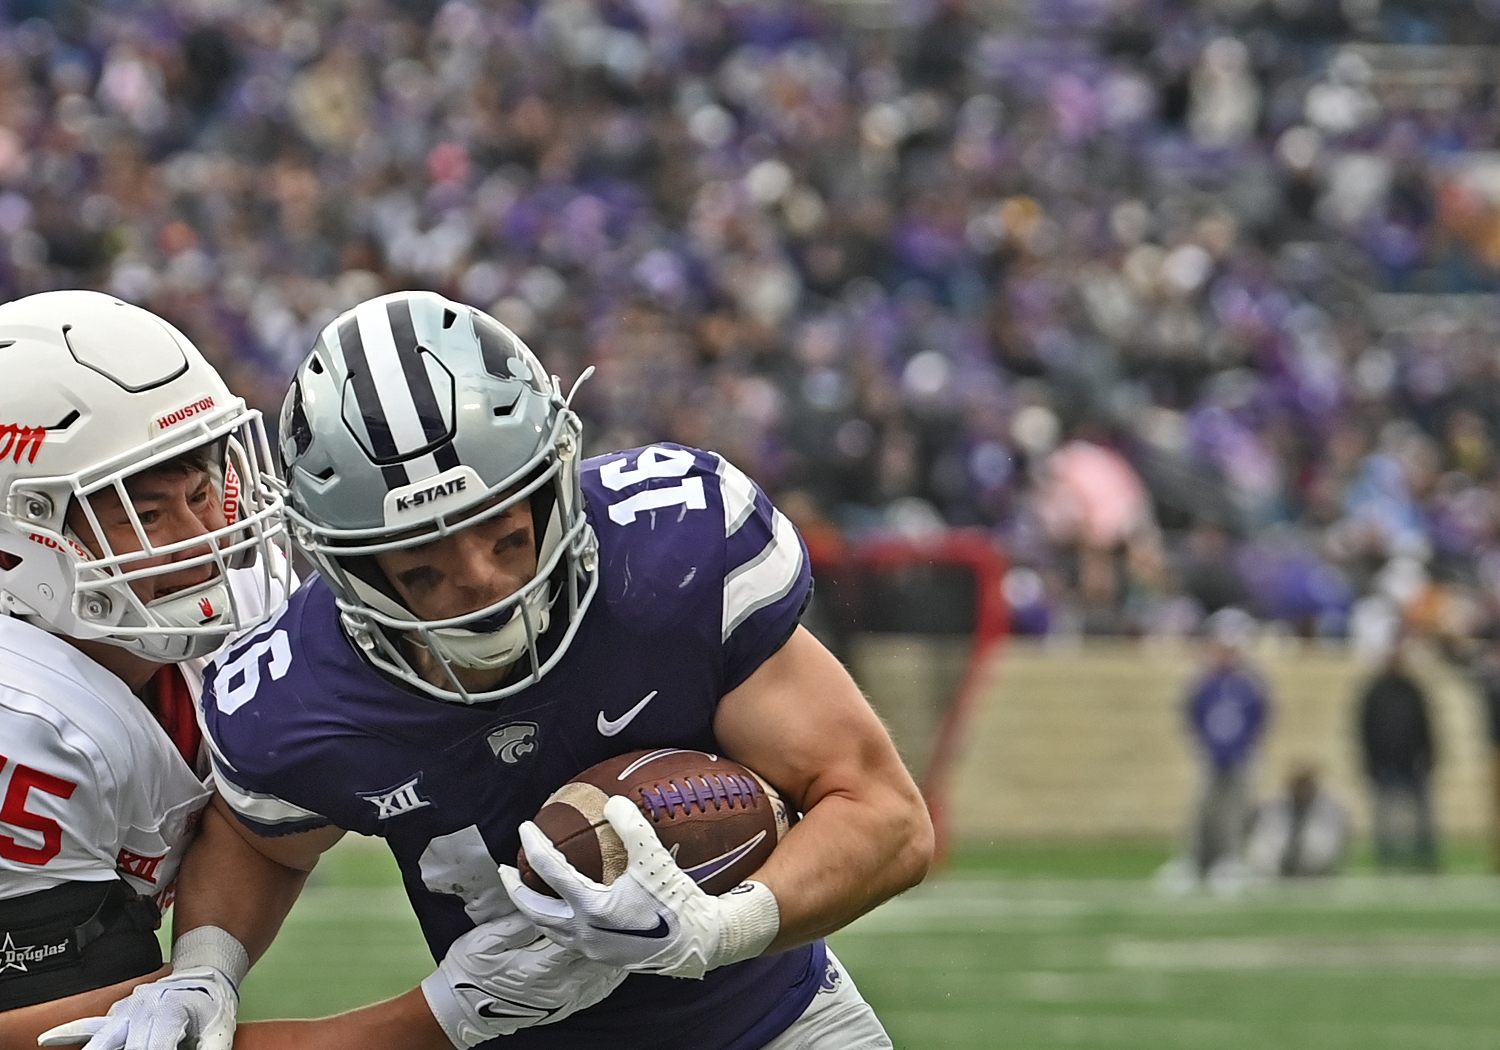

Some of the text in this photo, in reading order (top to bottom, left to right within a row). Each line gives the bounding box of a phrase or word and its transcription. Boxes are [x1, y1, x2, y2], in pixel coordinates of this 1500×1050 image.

[157, 395, 215, 429] HOUSTON
[396, 476, 466, 511] K-STATE
[600, 446, 707, 526] 16
[362, 778, 430, 820] XII
[5, 941, 67, 962] Douglas
